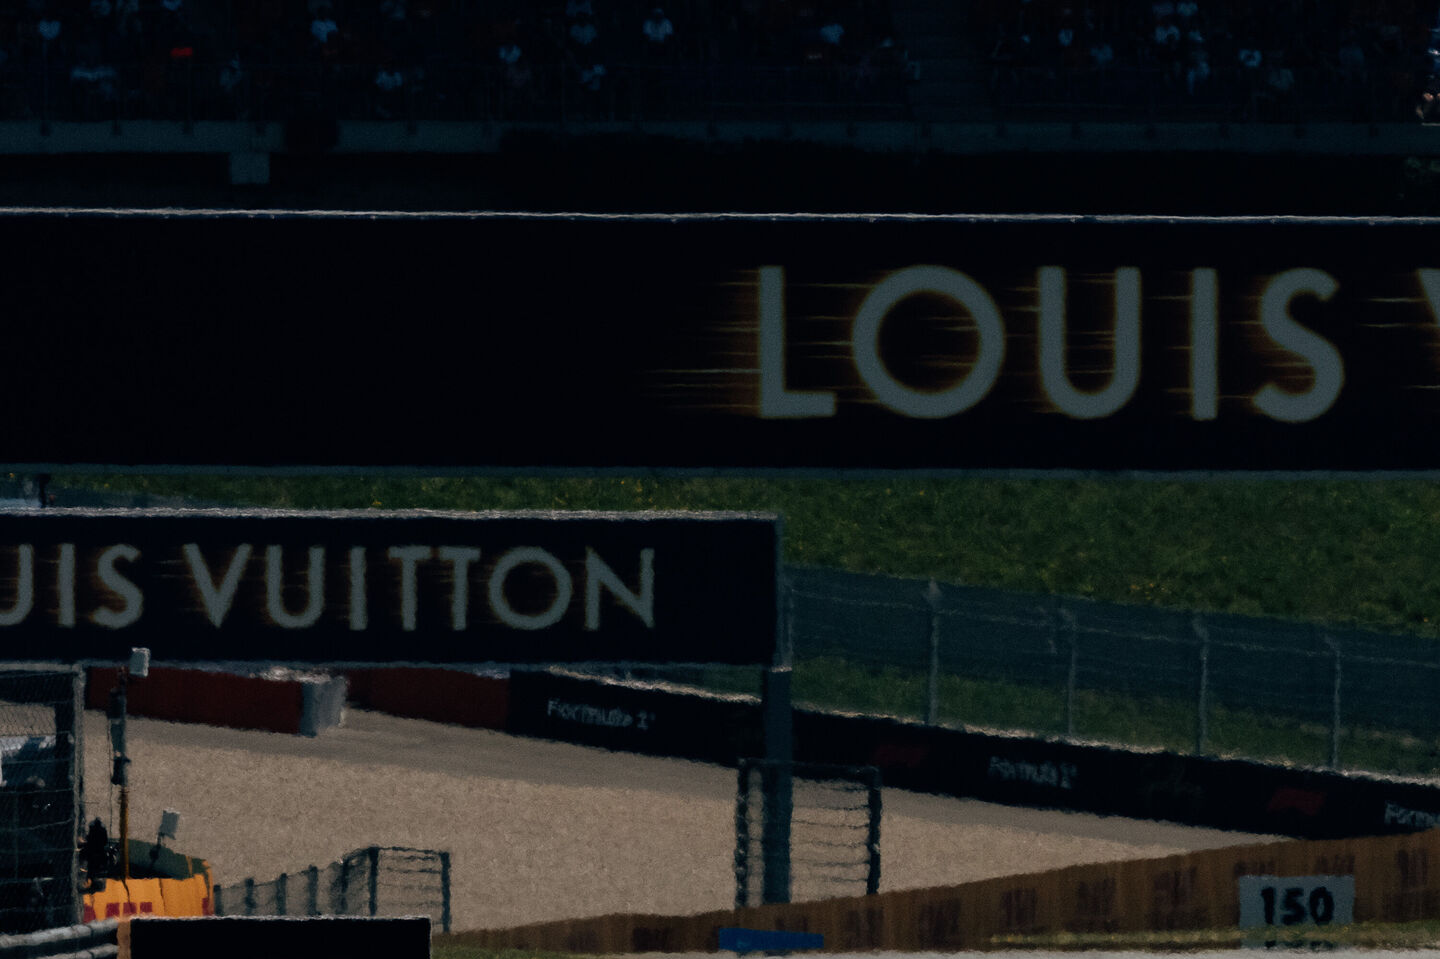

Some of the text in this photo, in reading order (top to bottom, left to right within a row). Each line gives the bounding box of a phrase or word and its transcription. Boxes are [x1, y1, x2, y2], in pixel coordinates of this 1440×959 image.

[757, 263, 1346, 424] LOUIS
[182, 543, 655, 631] VUITTON
[547, 697, 633, 727] Formula
[1261, 886, 1334, 926] 150
